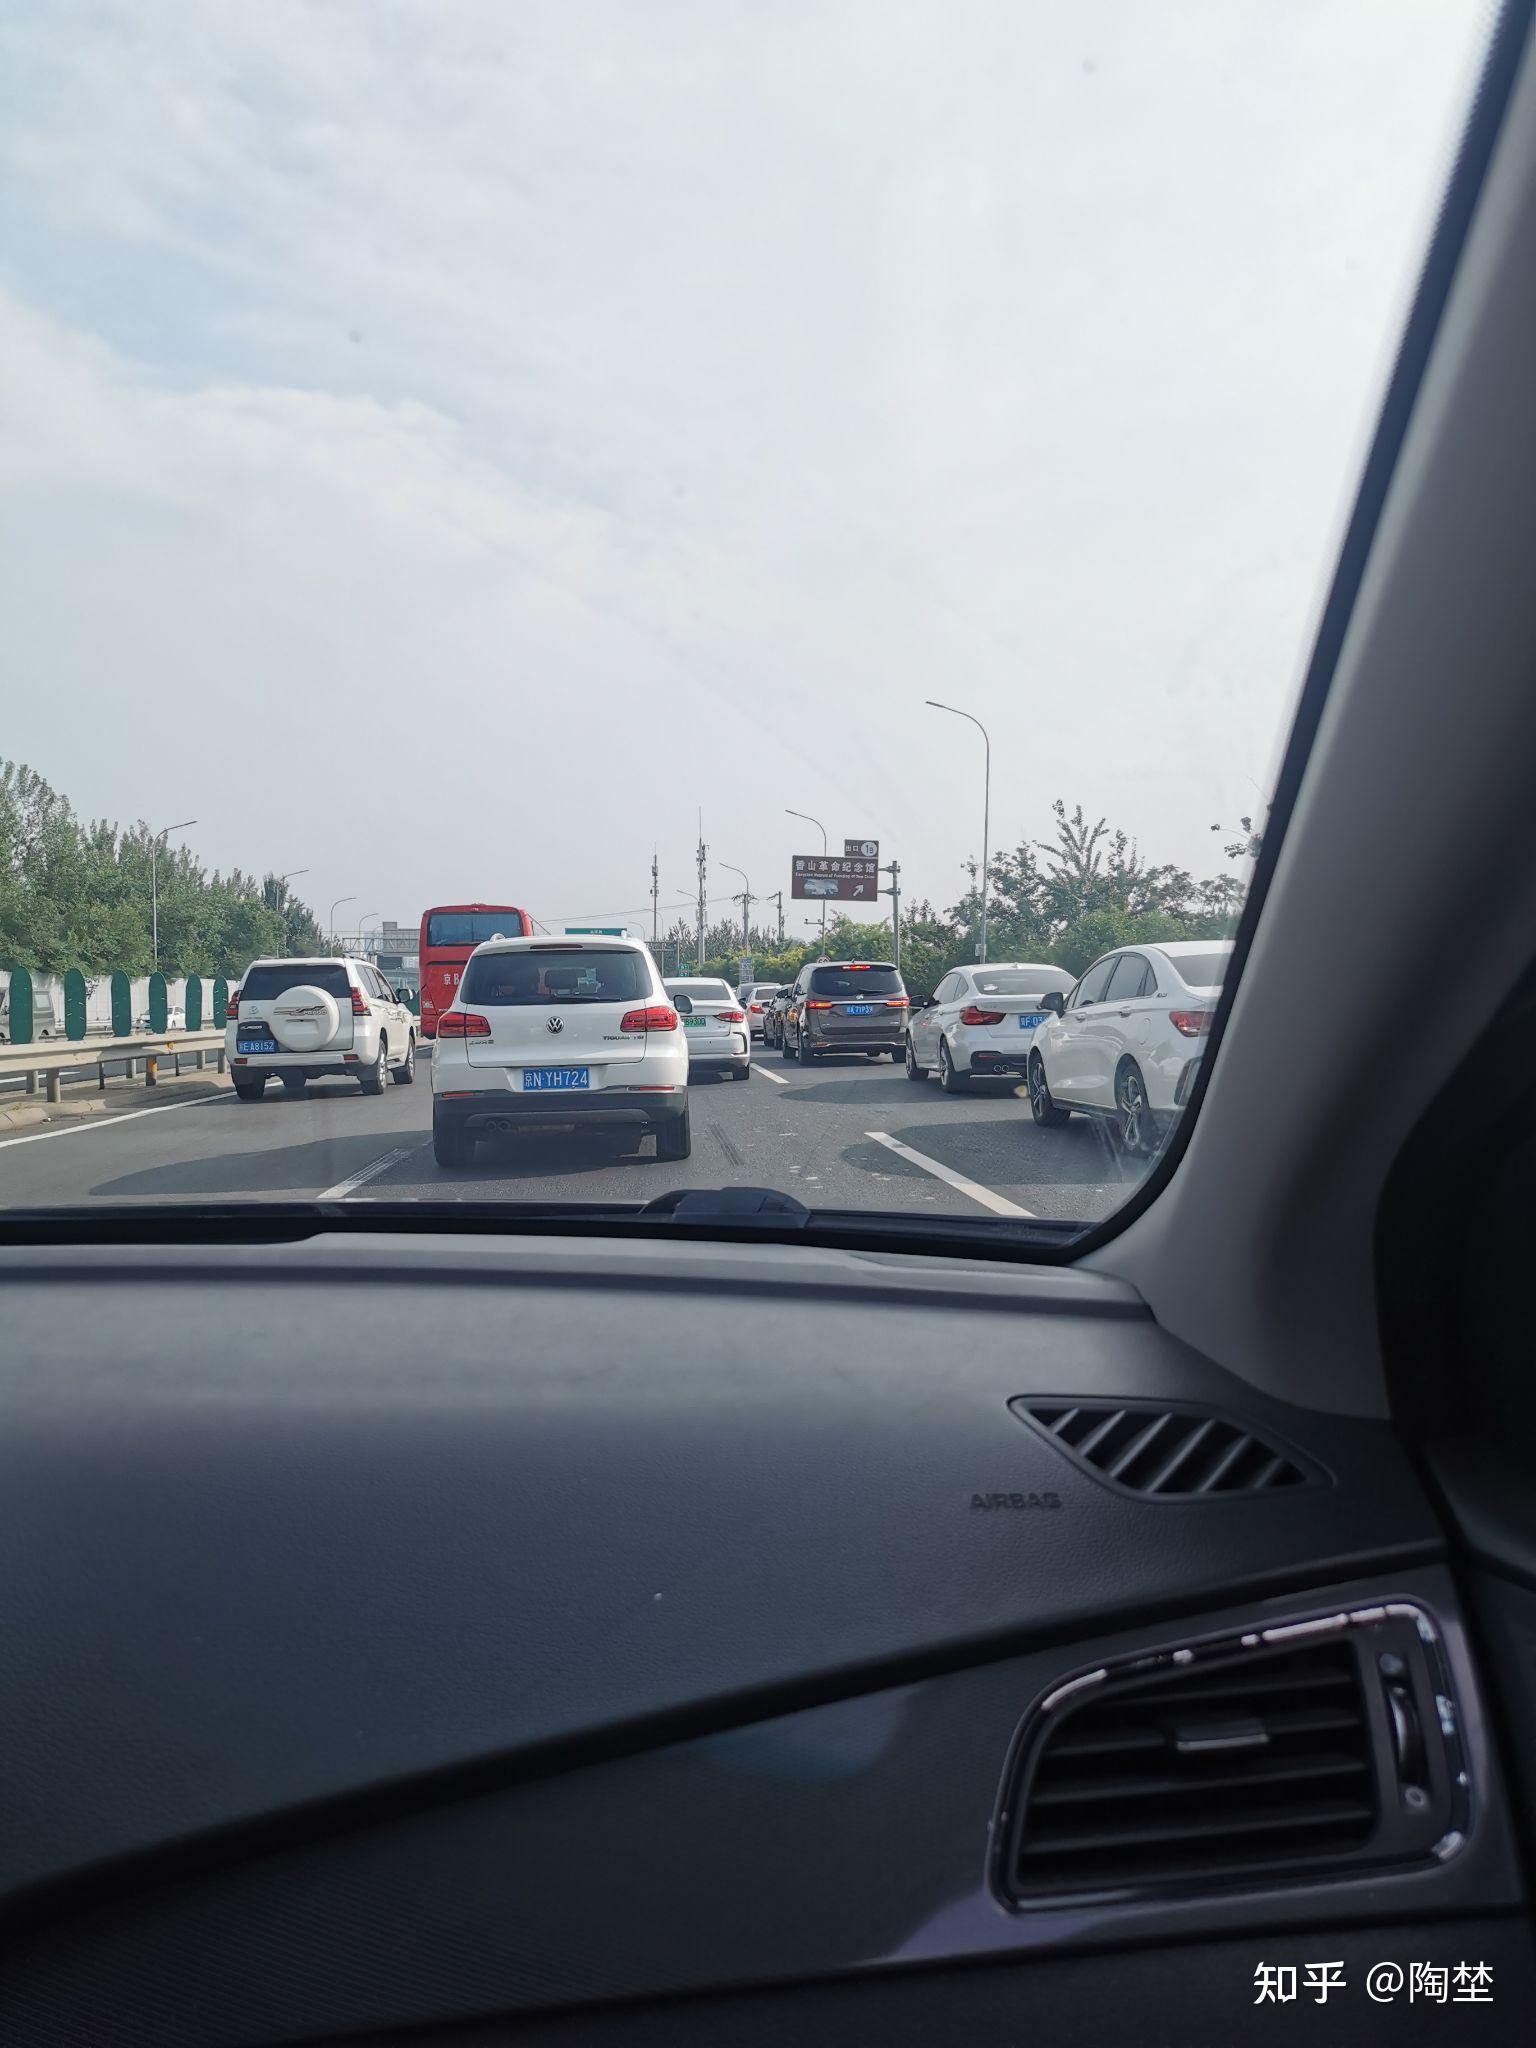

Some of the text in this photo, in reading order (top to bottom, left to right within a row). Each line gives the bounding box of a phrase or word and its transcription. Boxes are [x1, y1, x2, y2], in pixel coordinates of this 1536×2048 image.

[846, 844, 859, 852] 出口
[795, 860, 876, 873] 香山革命纪念馆
[969, 1492, 1062, 1510] AIRBAG
